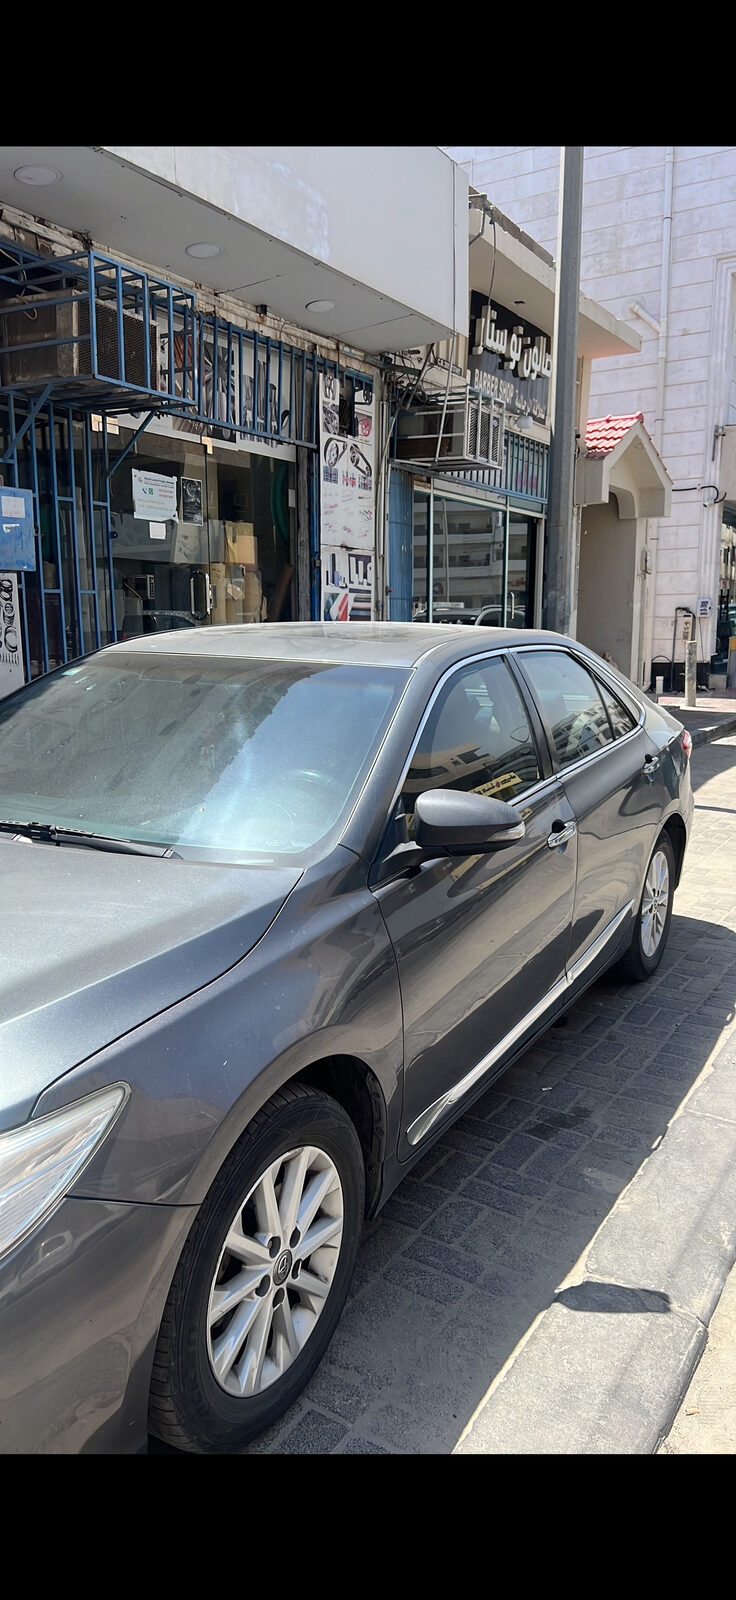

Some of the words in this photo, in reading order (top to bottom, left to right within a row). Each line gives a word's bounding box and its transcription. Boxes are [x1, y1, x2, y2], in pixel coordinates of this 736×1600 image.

[473, 305, 508, 356] ستار
[506, 325, 524, 370] تو
[520, 336, 552, 380] صالون
[474, 368, 499, 399] BARBER
[499, 379, 515, 404] SHOP
